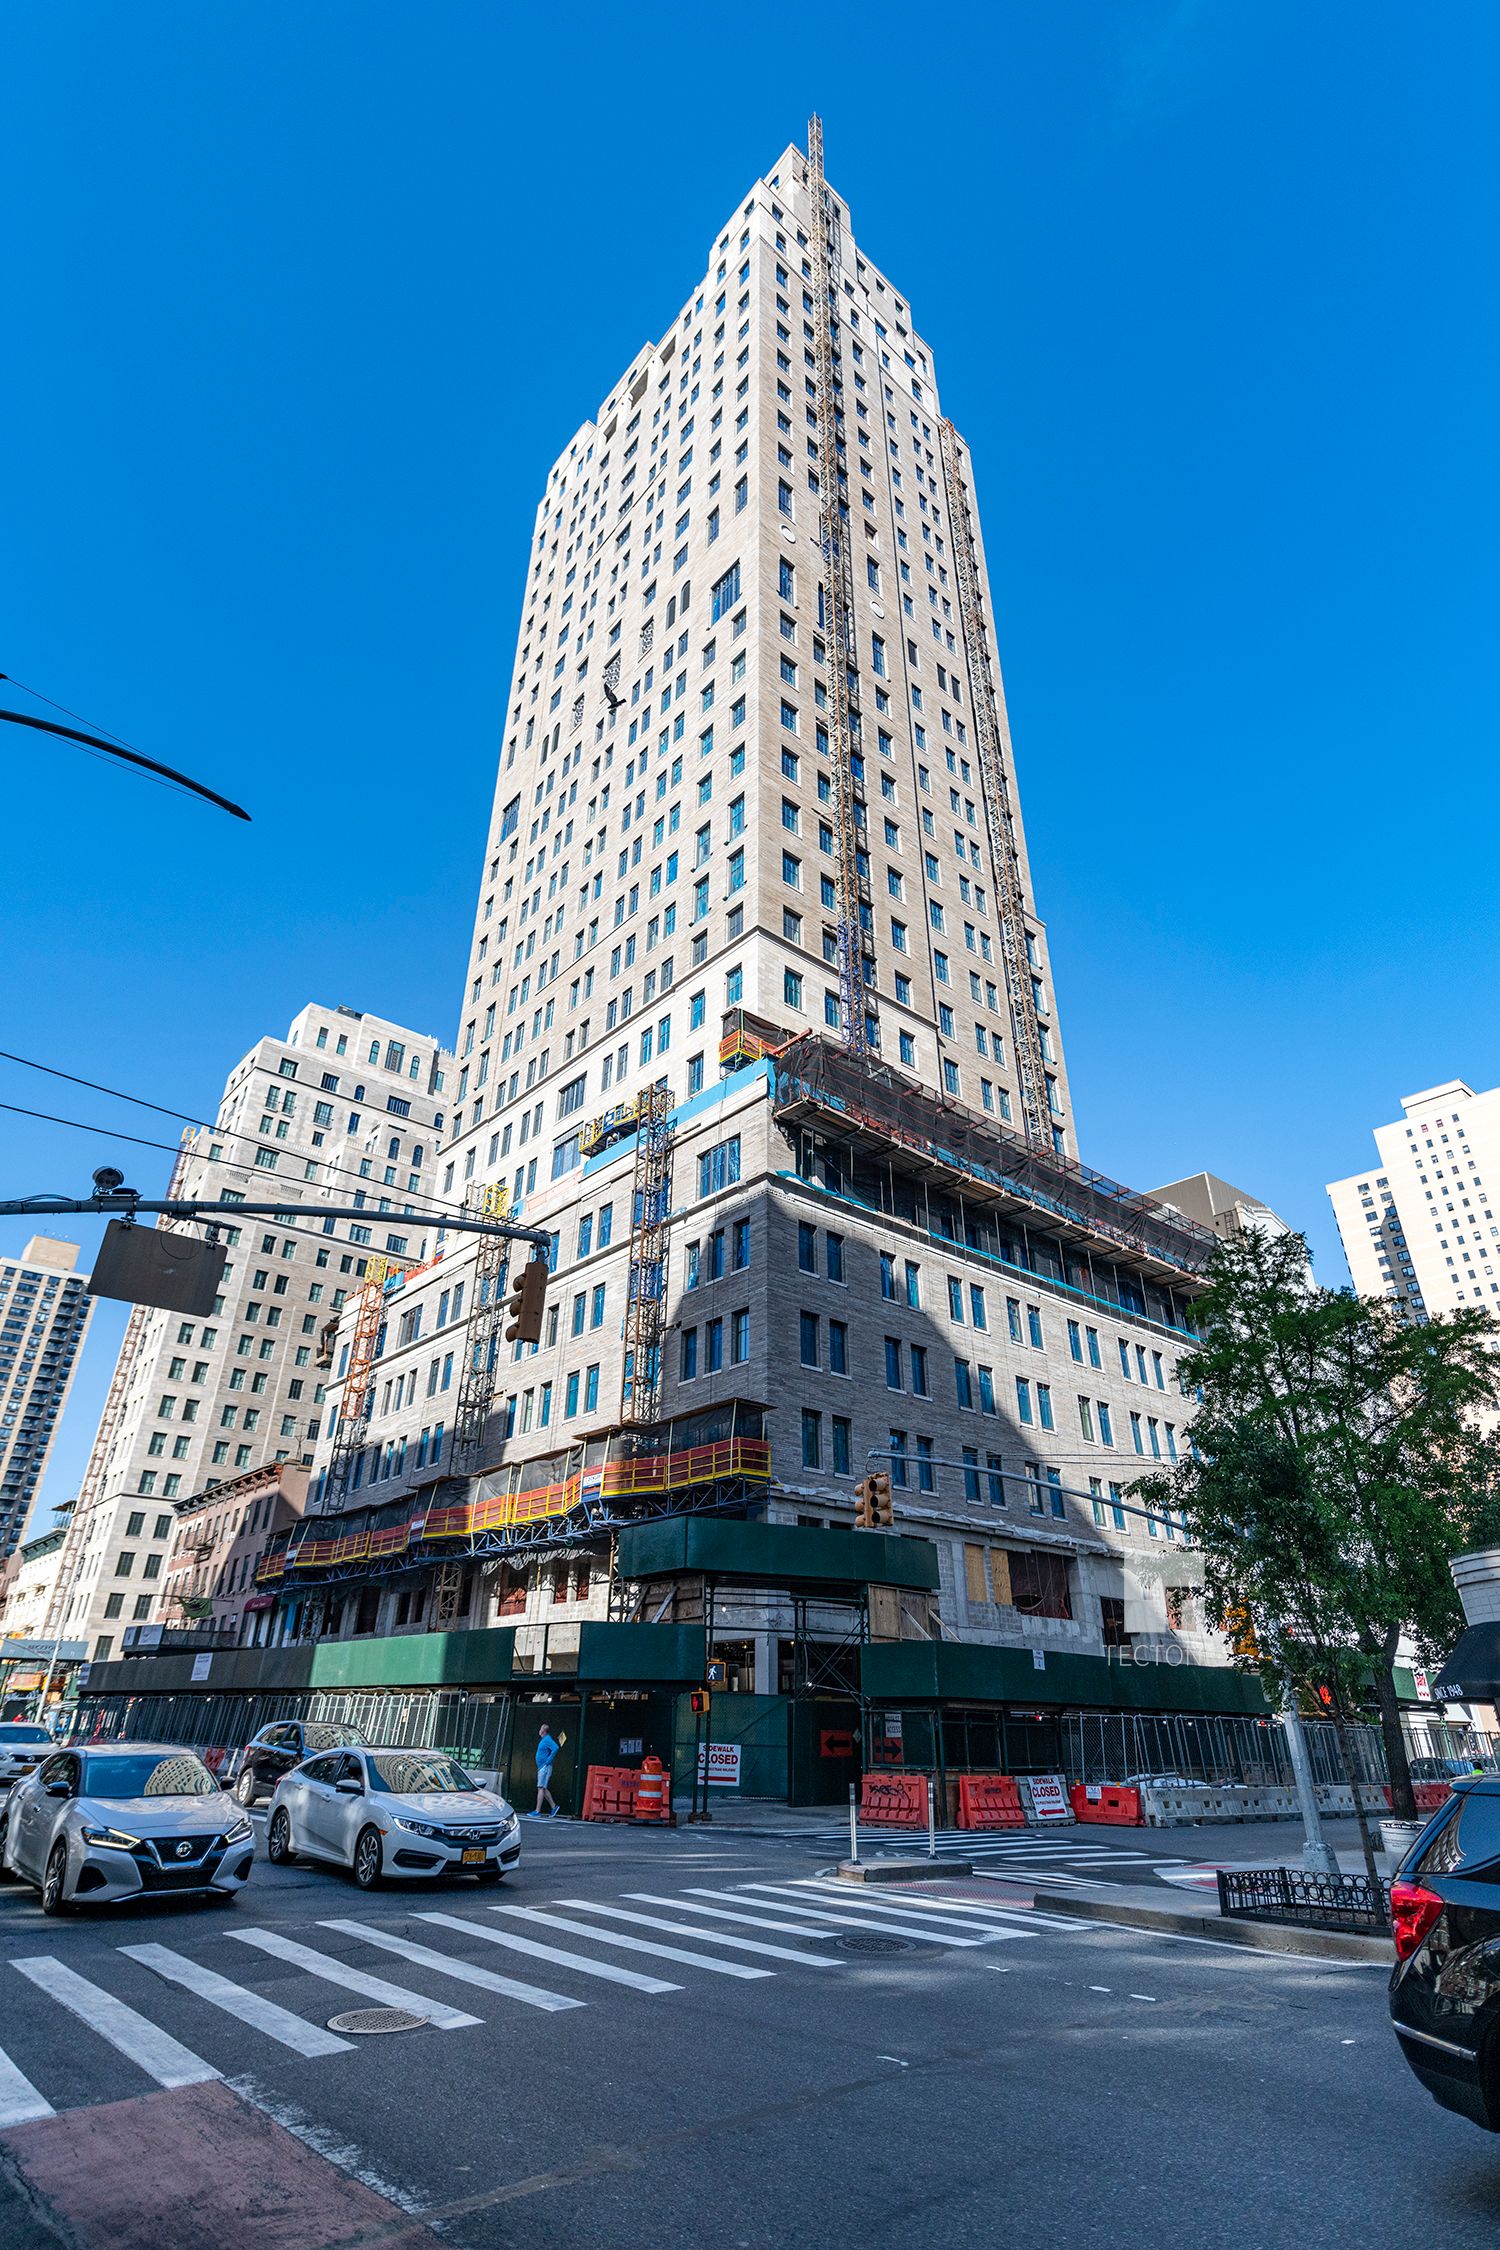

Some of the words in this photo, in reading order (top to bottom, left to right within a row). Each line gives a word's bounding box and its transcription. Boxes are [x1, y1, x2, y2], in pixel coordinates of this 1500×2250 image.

[1447, 1684, 1464, 1697] 1948
[698, 1753, 738, 1764] COSED
[1032, 1777, 1055, 1785] SIDEWALK
[1032, 1786, 1060, 1798] CLOSED
